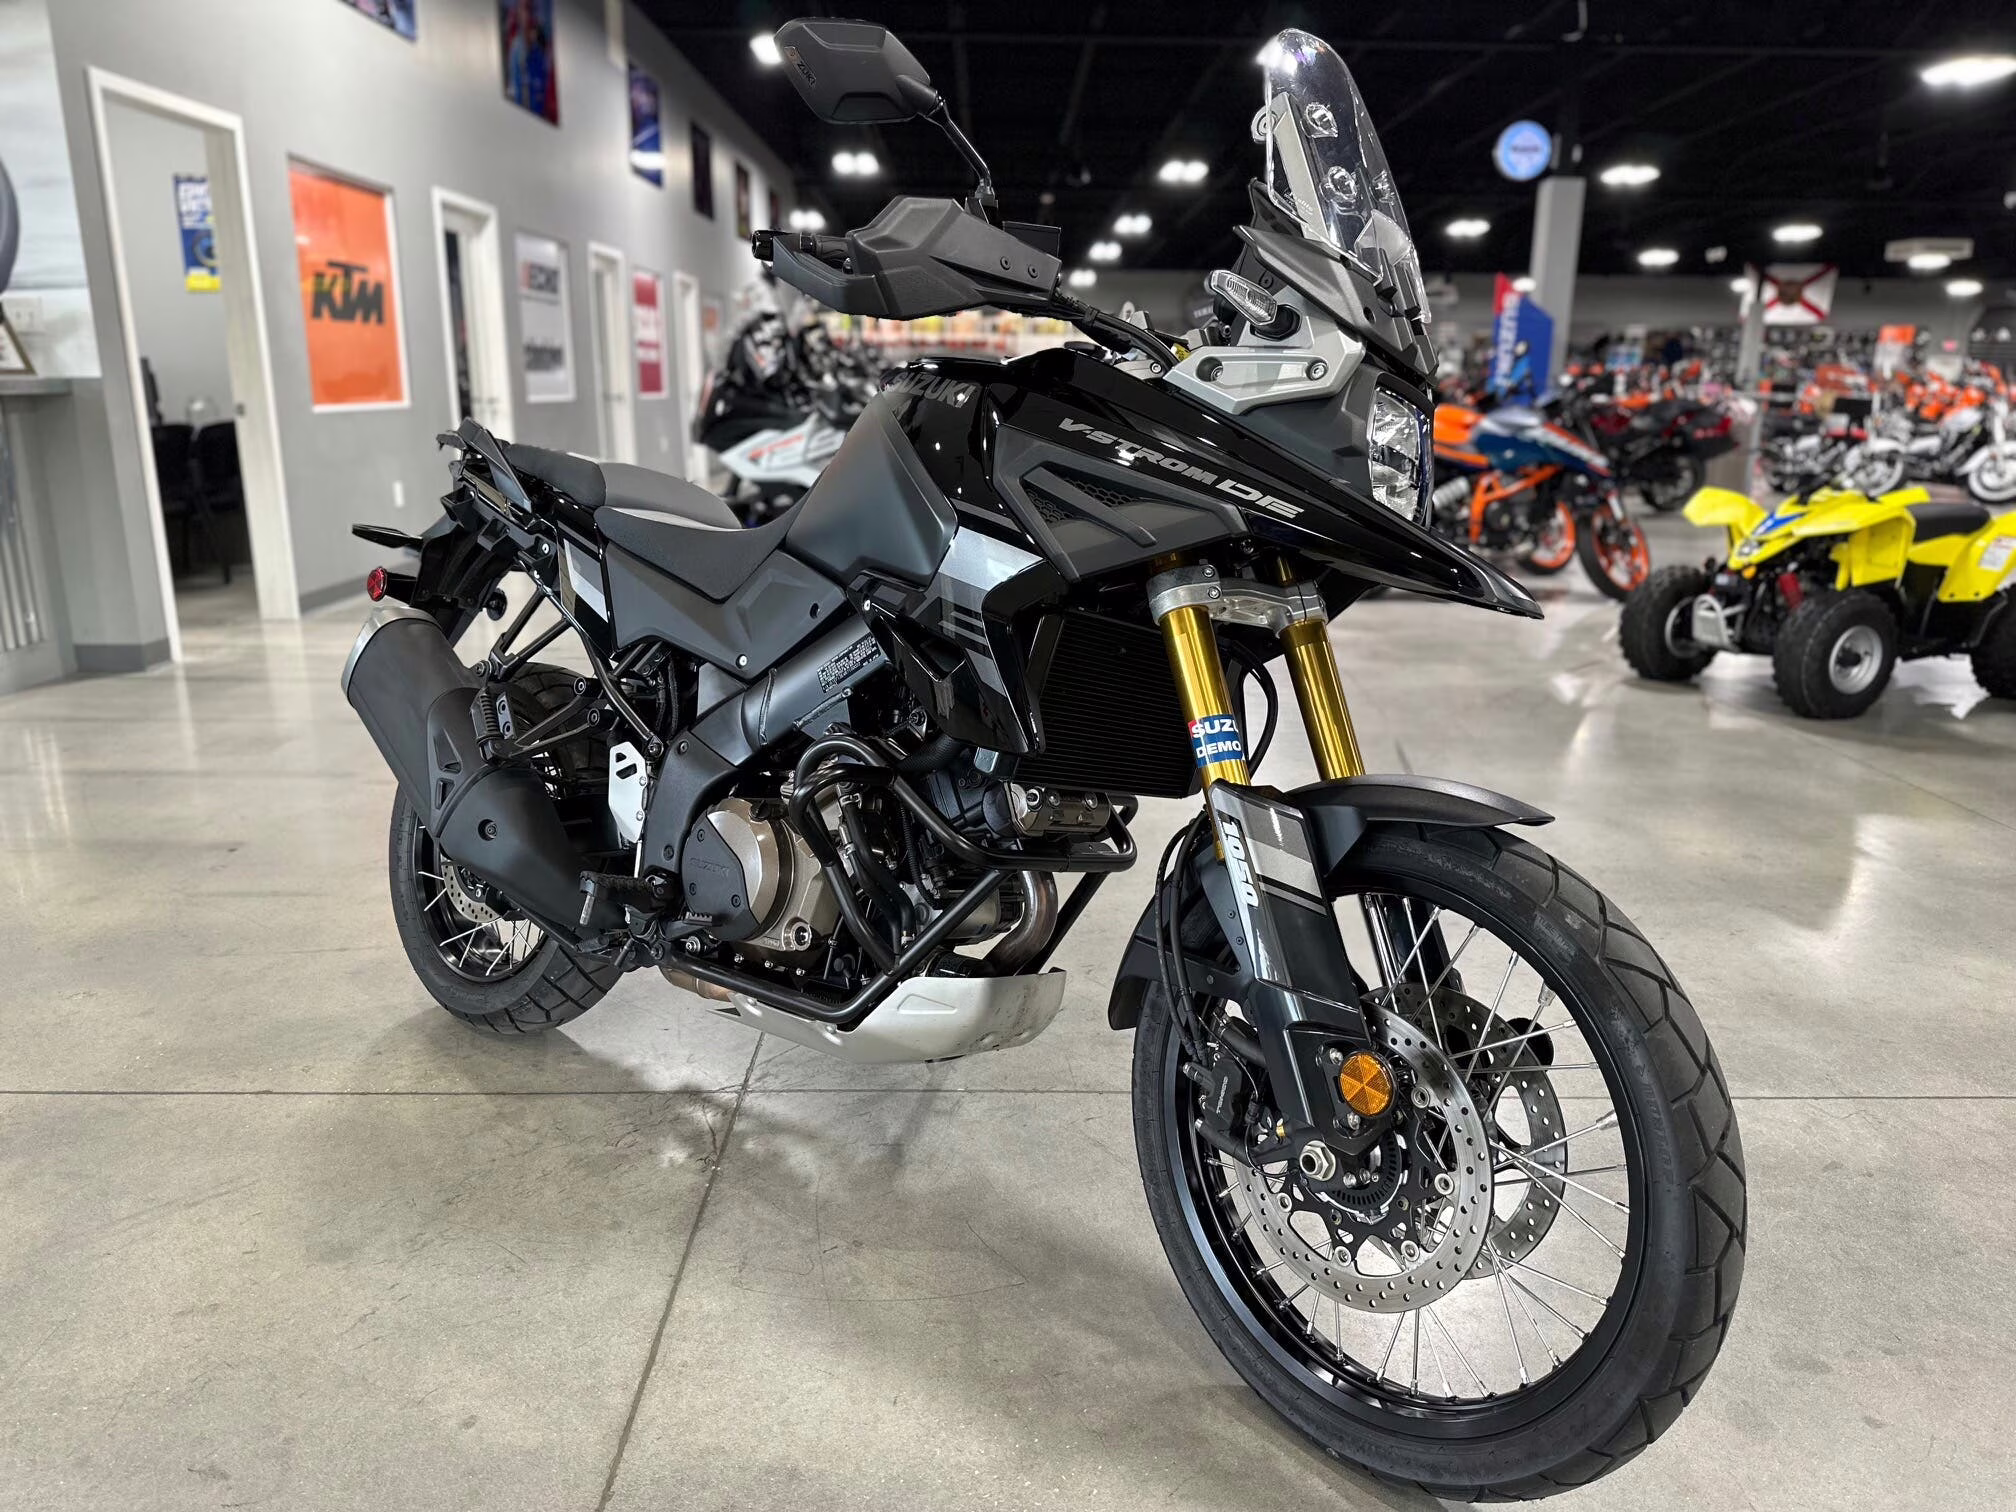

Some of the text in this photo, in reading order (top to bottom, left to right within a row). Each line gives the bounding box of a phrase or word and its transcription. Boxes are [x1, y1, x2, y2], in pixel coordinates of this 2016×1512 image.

[311, 258, 385, 325] KTM
[1058, 417, 1305, 519] V-STROM DE
[1195, 740, 1242, 759] DEMO
[1221, 818, 1259, 908] 1050
